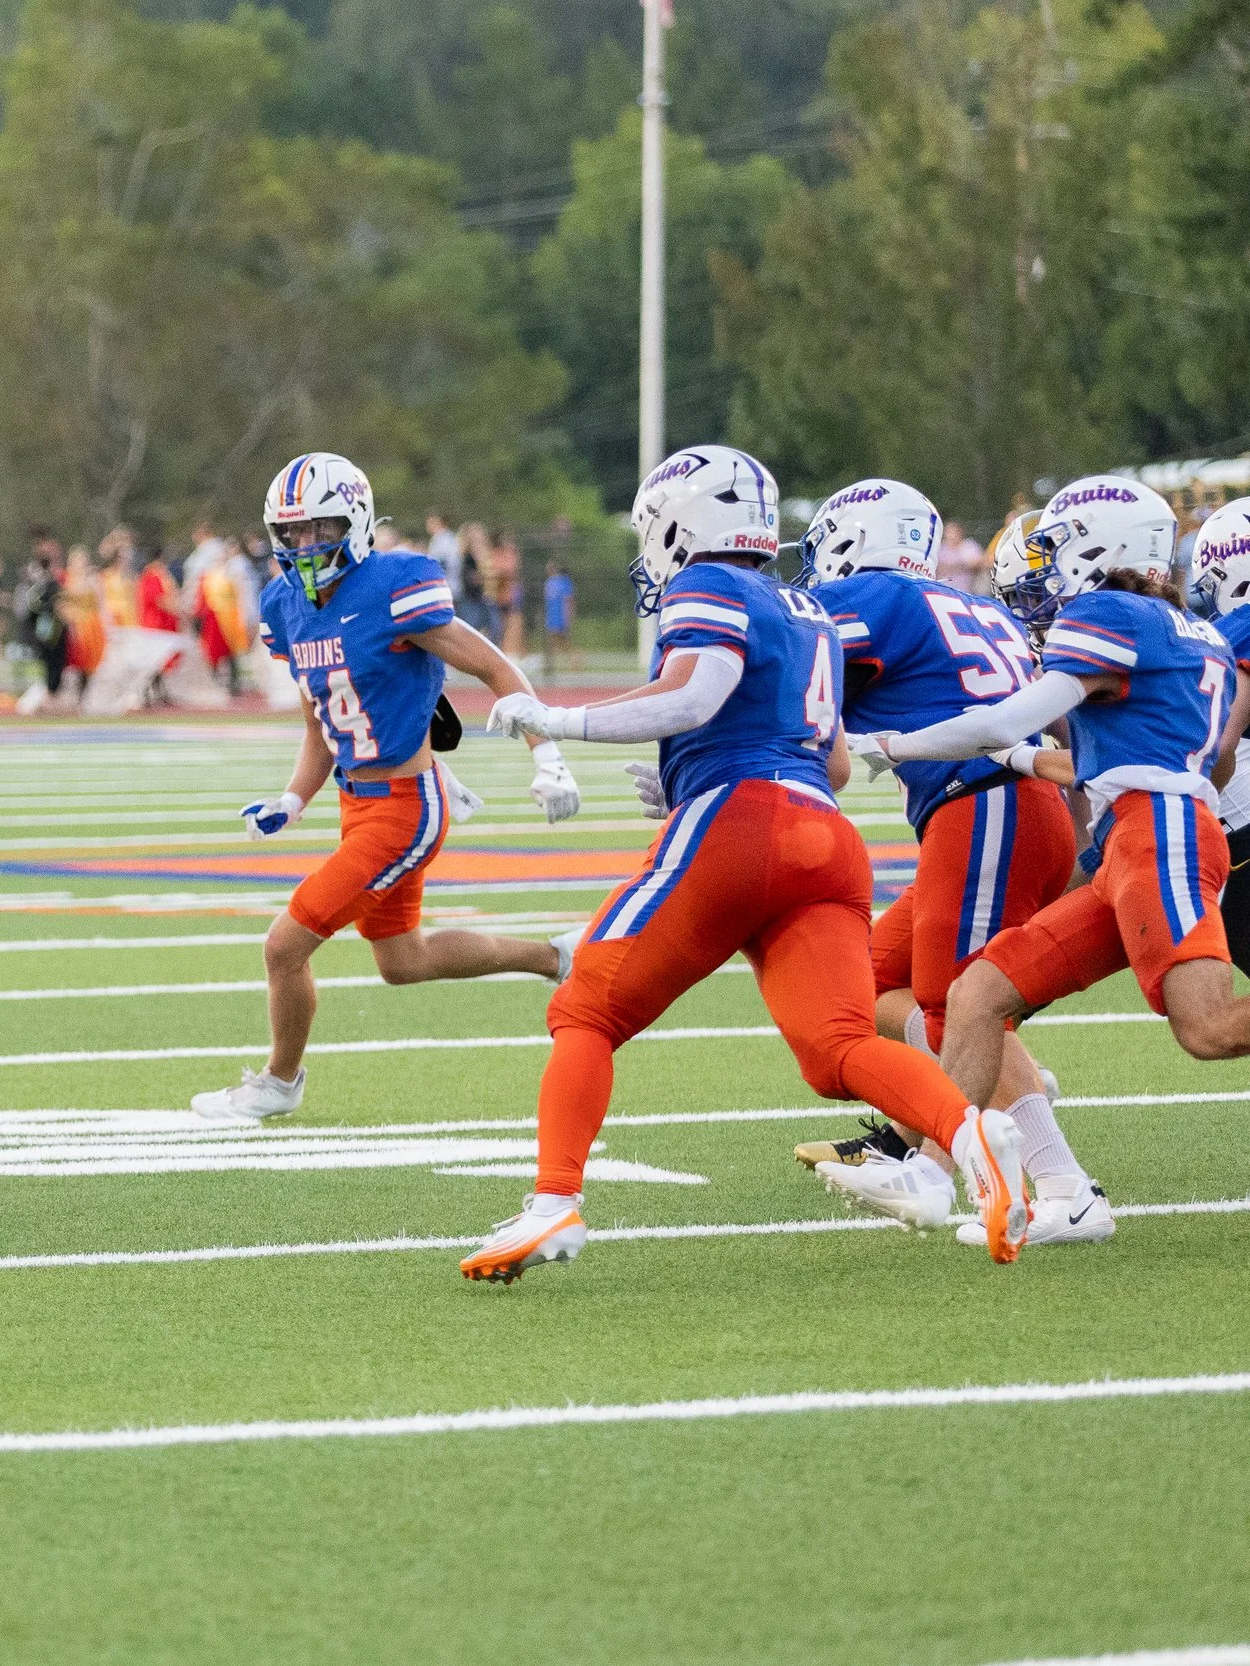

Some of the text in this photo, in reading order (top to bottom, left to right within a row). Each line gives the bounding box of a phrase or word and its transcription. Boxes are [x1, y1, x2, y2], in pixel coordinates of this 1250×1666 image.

[1051, 484, 1136, 515] Bruins
[291, 636, 345, 670] BRUINS
[800, 633, 837, 751] 4
[923, 591, 1032, 699] 52
[298, 667, 379, 761] 14
[1186, 656, 1227, 775] 7
